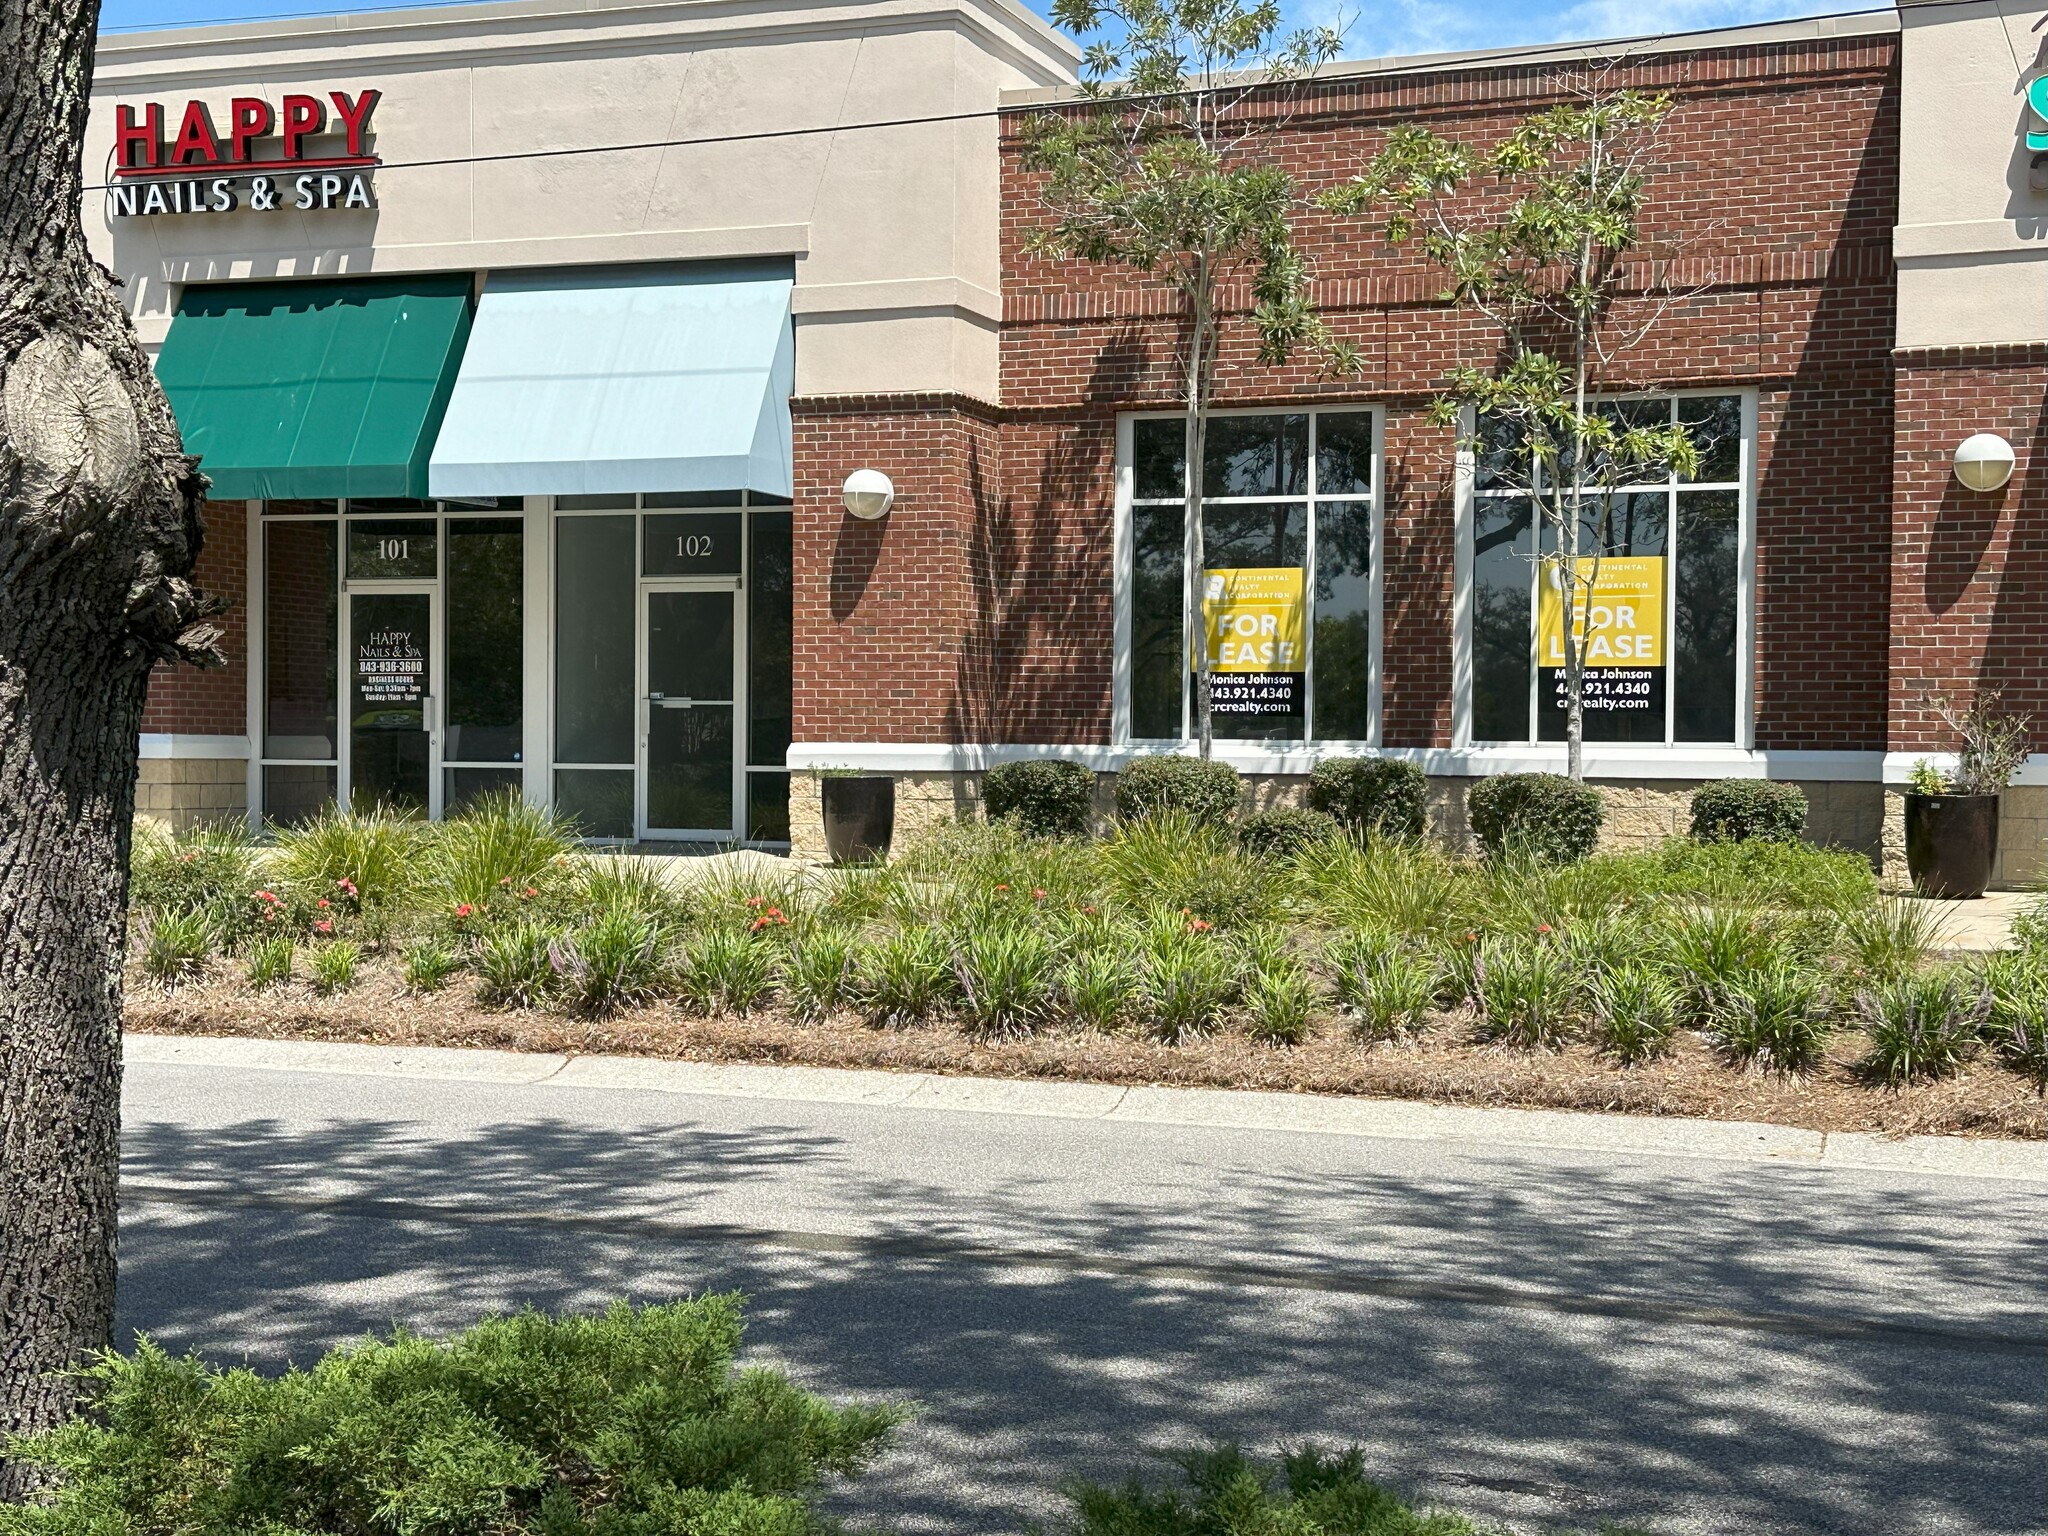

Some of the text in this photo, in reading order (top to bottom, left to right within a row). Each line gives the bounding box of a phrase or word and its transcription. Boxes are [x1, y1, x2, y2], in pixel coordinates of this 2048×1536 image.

[116, 89, 381, 166] HAPPY
[112, 174, 373, 216] NAILS & SPA
[378, 539, 408, 559] 101
[676, 535, 712, 557] 102
[1572, 605, 1636, 629] FOR
[1218, 614, 1279, 637] FOR
[370, 632, 411, 645] HAPPY
[392, 646, 403, 658] &
[1210, 673, 1293, 685] Monica Johnson
[1554, 667, 1652, 679] Mica Johnson
[1210, 687, 1291, 699] 443.921.4340
[1555, 682, 1650, 695] 4.921.4340
[1210, 700, 1291, 715] crcrealty.com
[1556, 696, 1649, 711] crealty.com
